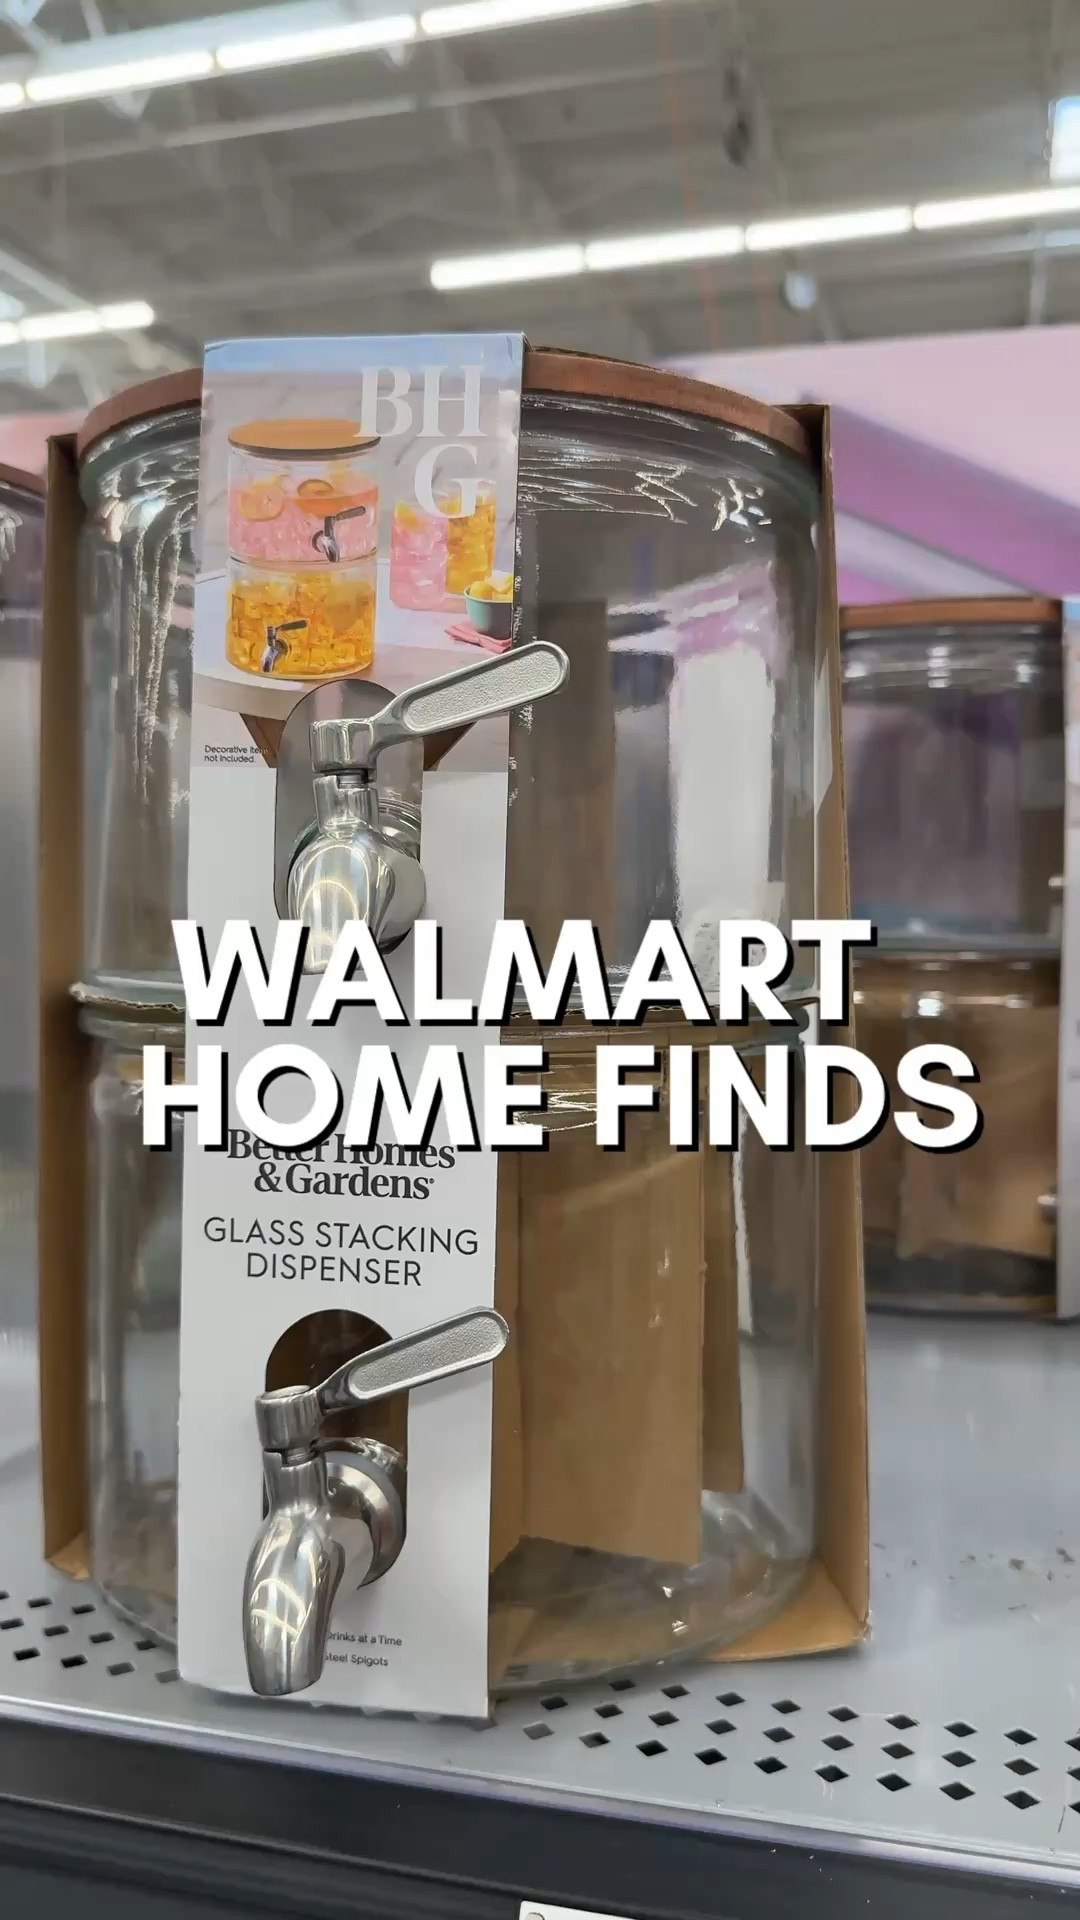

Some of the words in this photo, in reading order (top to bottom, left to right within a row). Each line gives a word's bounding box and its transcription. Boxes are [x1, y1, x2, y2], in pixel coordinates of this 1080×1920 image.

[353, 364, 488, 438] BH
[414, 442, 479, 519] G
[204, 744, 248, 754] Decorative
[204, 754, 218, 762] not
[203, 1216, 305, 1246] GLASS
[315, 1221, 479, 1256] STACKING
[247, 1252, 422, 1287] DISPENSER
[358, 1634, 368, 1643] at
[379, 1635, 403, 1646] Time
[351, 1654, 389, 1667] Spigots
